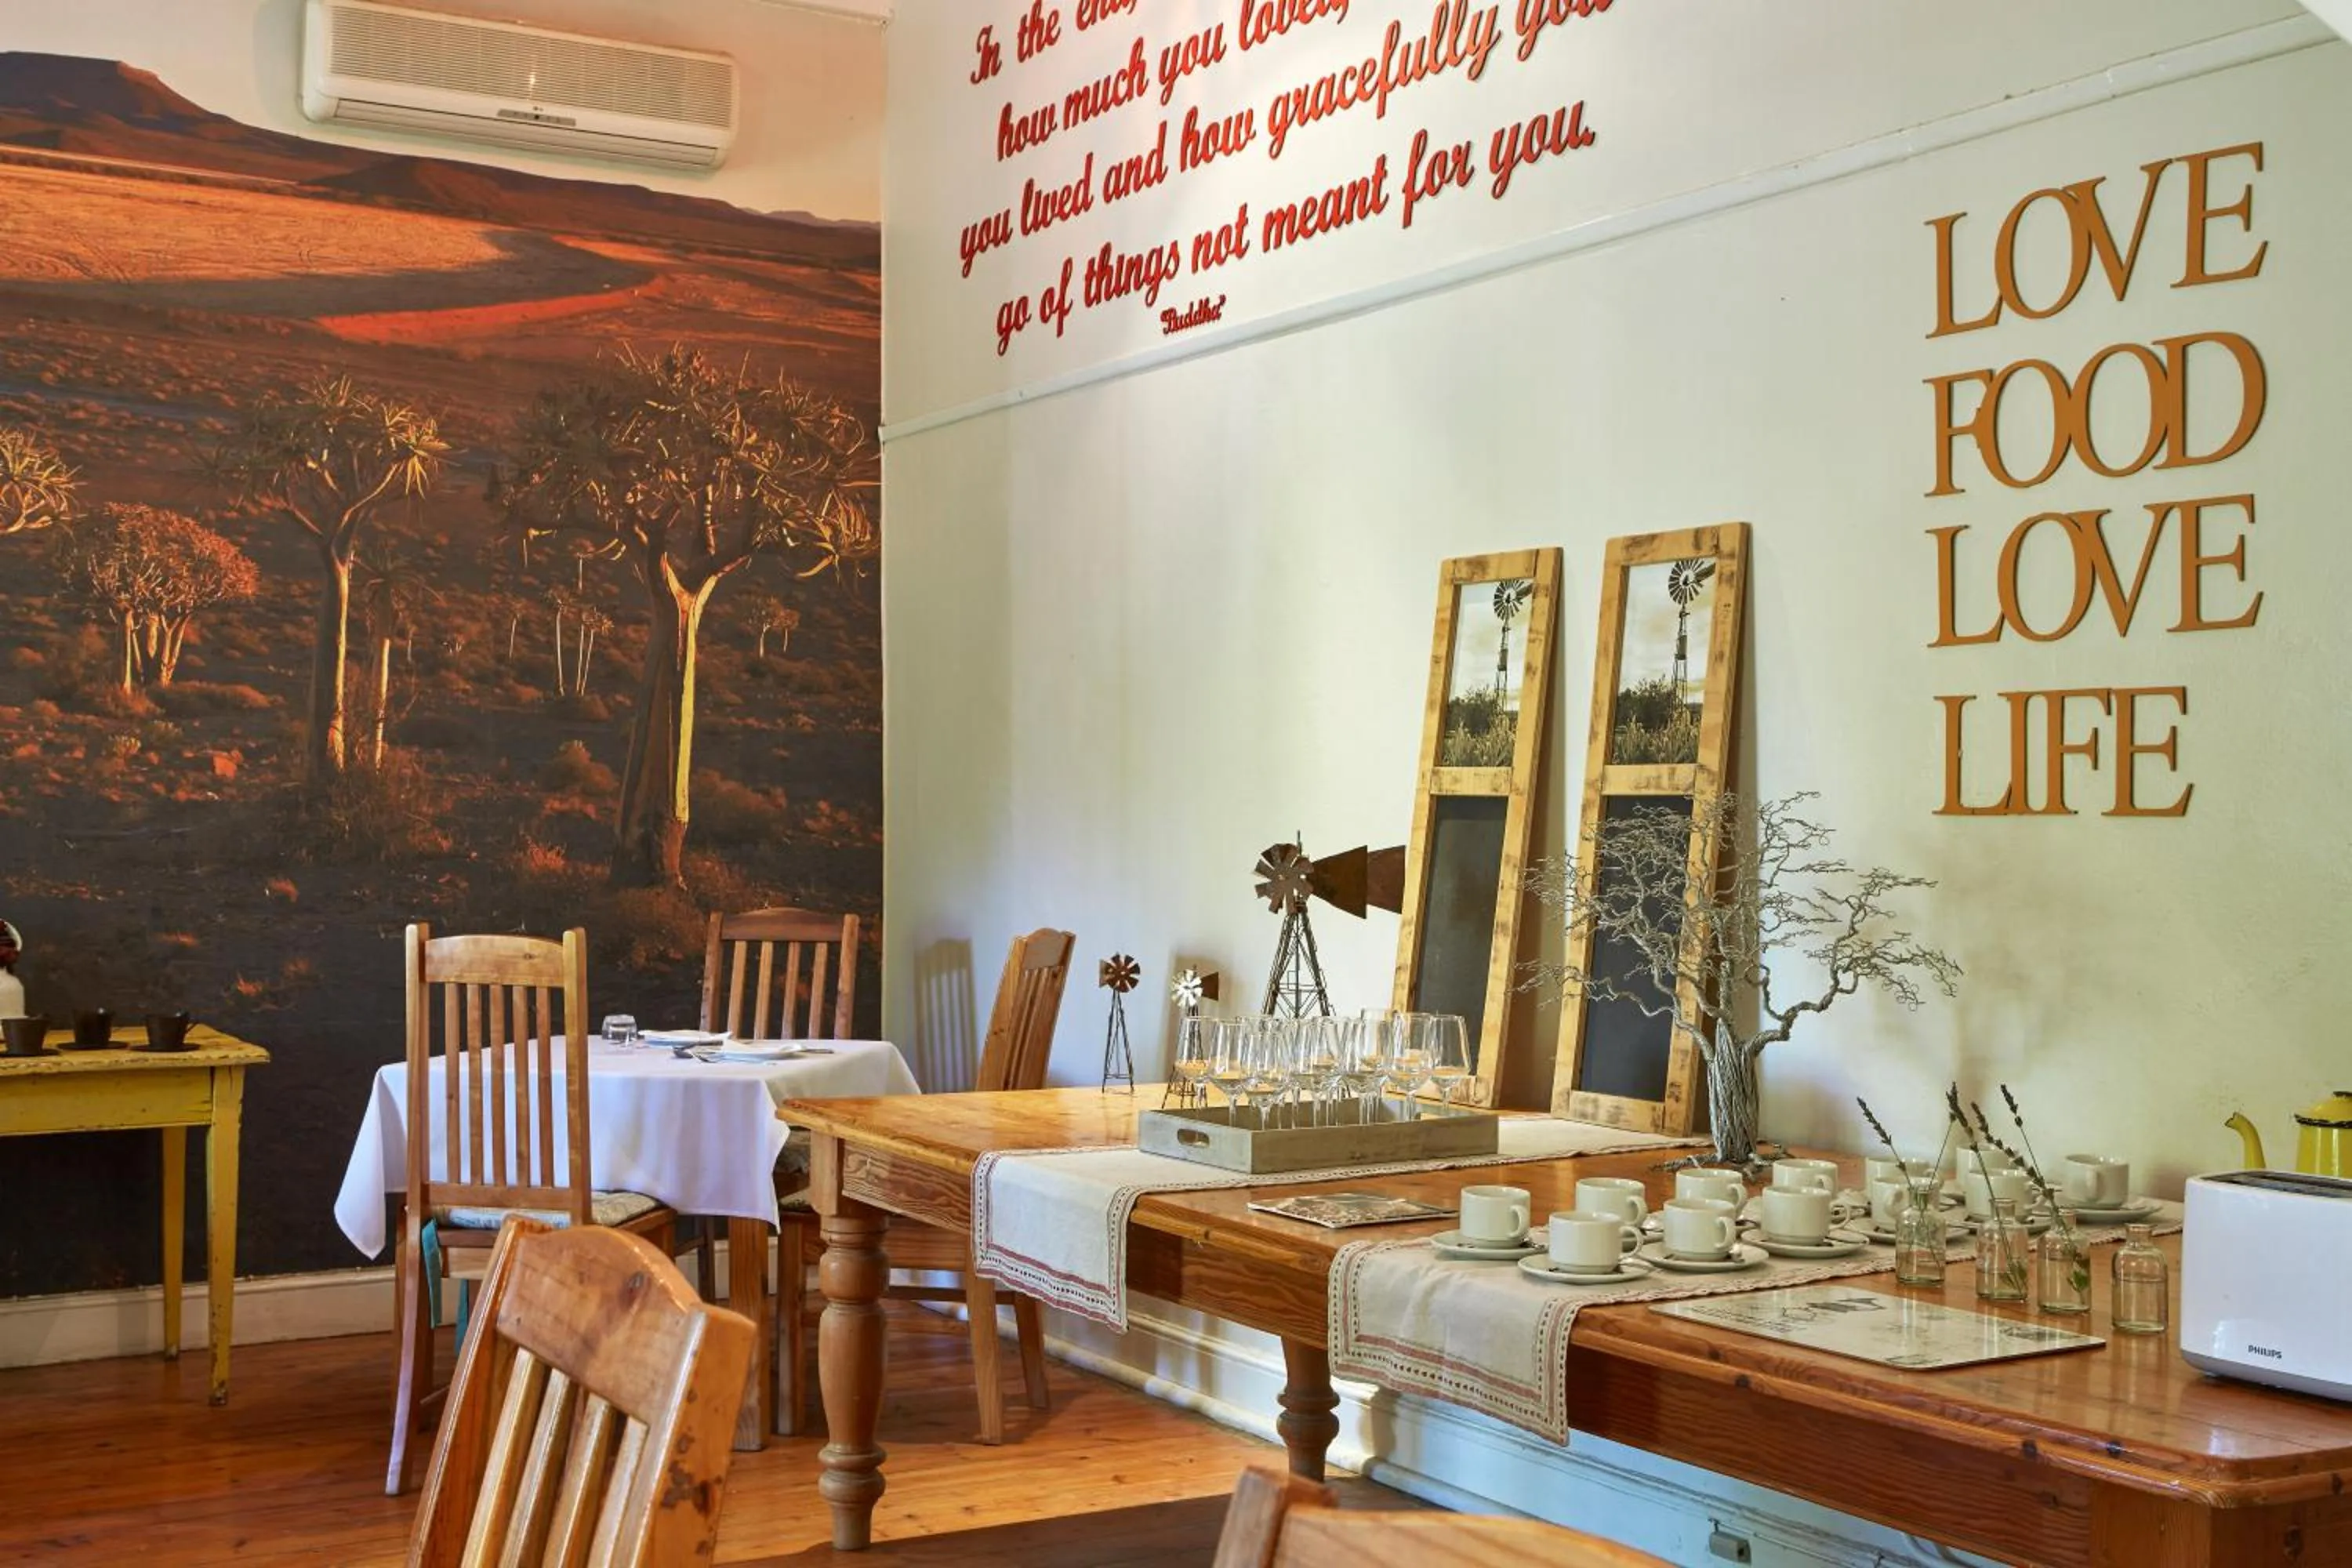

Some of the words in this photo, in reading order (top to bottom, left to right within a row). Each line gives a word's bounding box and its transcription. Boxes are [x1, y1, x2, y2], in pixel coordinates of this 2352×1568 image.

[970, 24, 1002, 85] In
[1016, 0, 1061, 64] the
[996, 101, 1058, 160] how
[1062, 36, 1149, 130] much
[1158, 22, 1227, 107] you
[959, 209, 1013, 278] you
[1020, 151, 1094, 237] lived
[1102, 120, 1168, 204] and
[1179, 106, 1256, 171] how
[1267, 0, 1501, 160] gracefully
[996, 295, 1032, 358] go
[1039, 256, 1074, 339] of
[1083, 241, 1181, 307] things
[1191, 202, 1250, 274] not
[1262, 154, 1389, 253] meant
[1402, 129, 1475, 229] for
[1488, 100, 1596, 199] you.
[1925, 141, 2268, 339] LOVE
[1922, 331, 2267, 499] FOOD
[1926, 493, 2264, 649] LOVE
[1932, 685, 2195, 819] LIFE
[2248, 1345, 2282, 1359] PHILIPS
